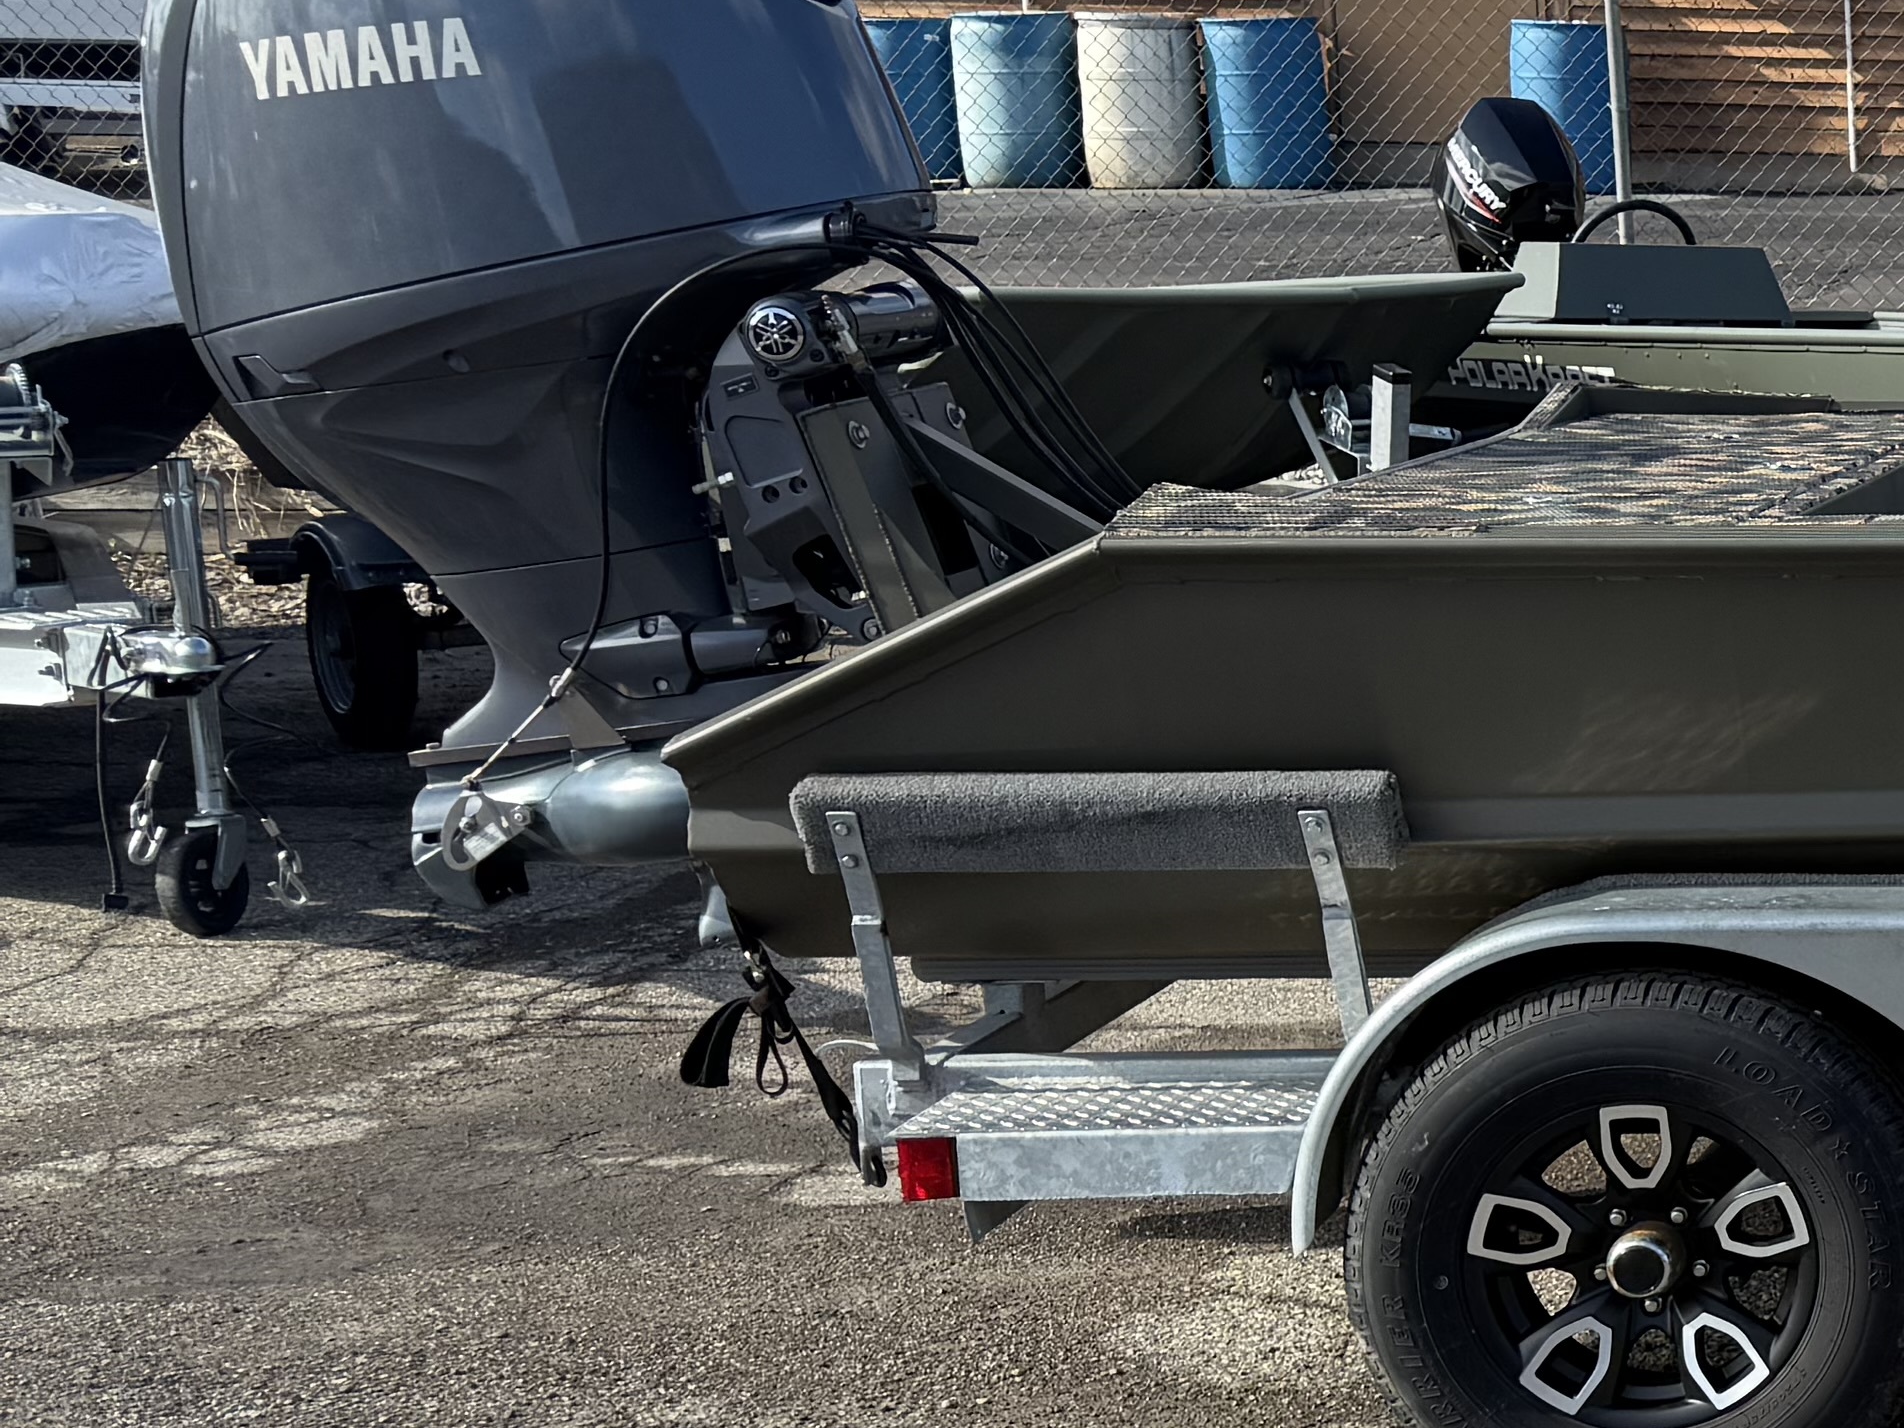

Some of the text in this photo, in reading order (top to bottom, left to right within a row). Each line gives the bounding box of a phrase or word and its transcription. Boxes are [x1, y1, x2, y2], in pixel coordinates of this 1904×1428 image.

[240, 16, 483, 101] YAMAHA
[1447, 136, 1508, 211] MERCURY
[1713, 1044, 1893, 1291] LOAD STAR
